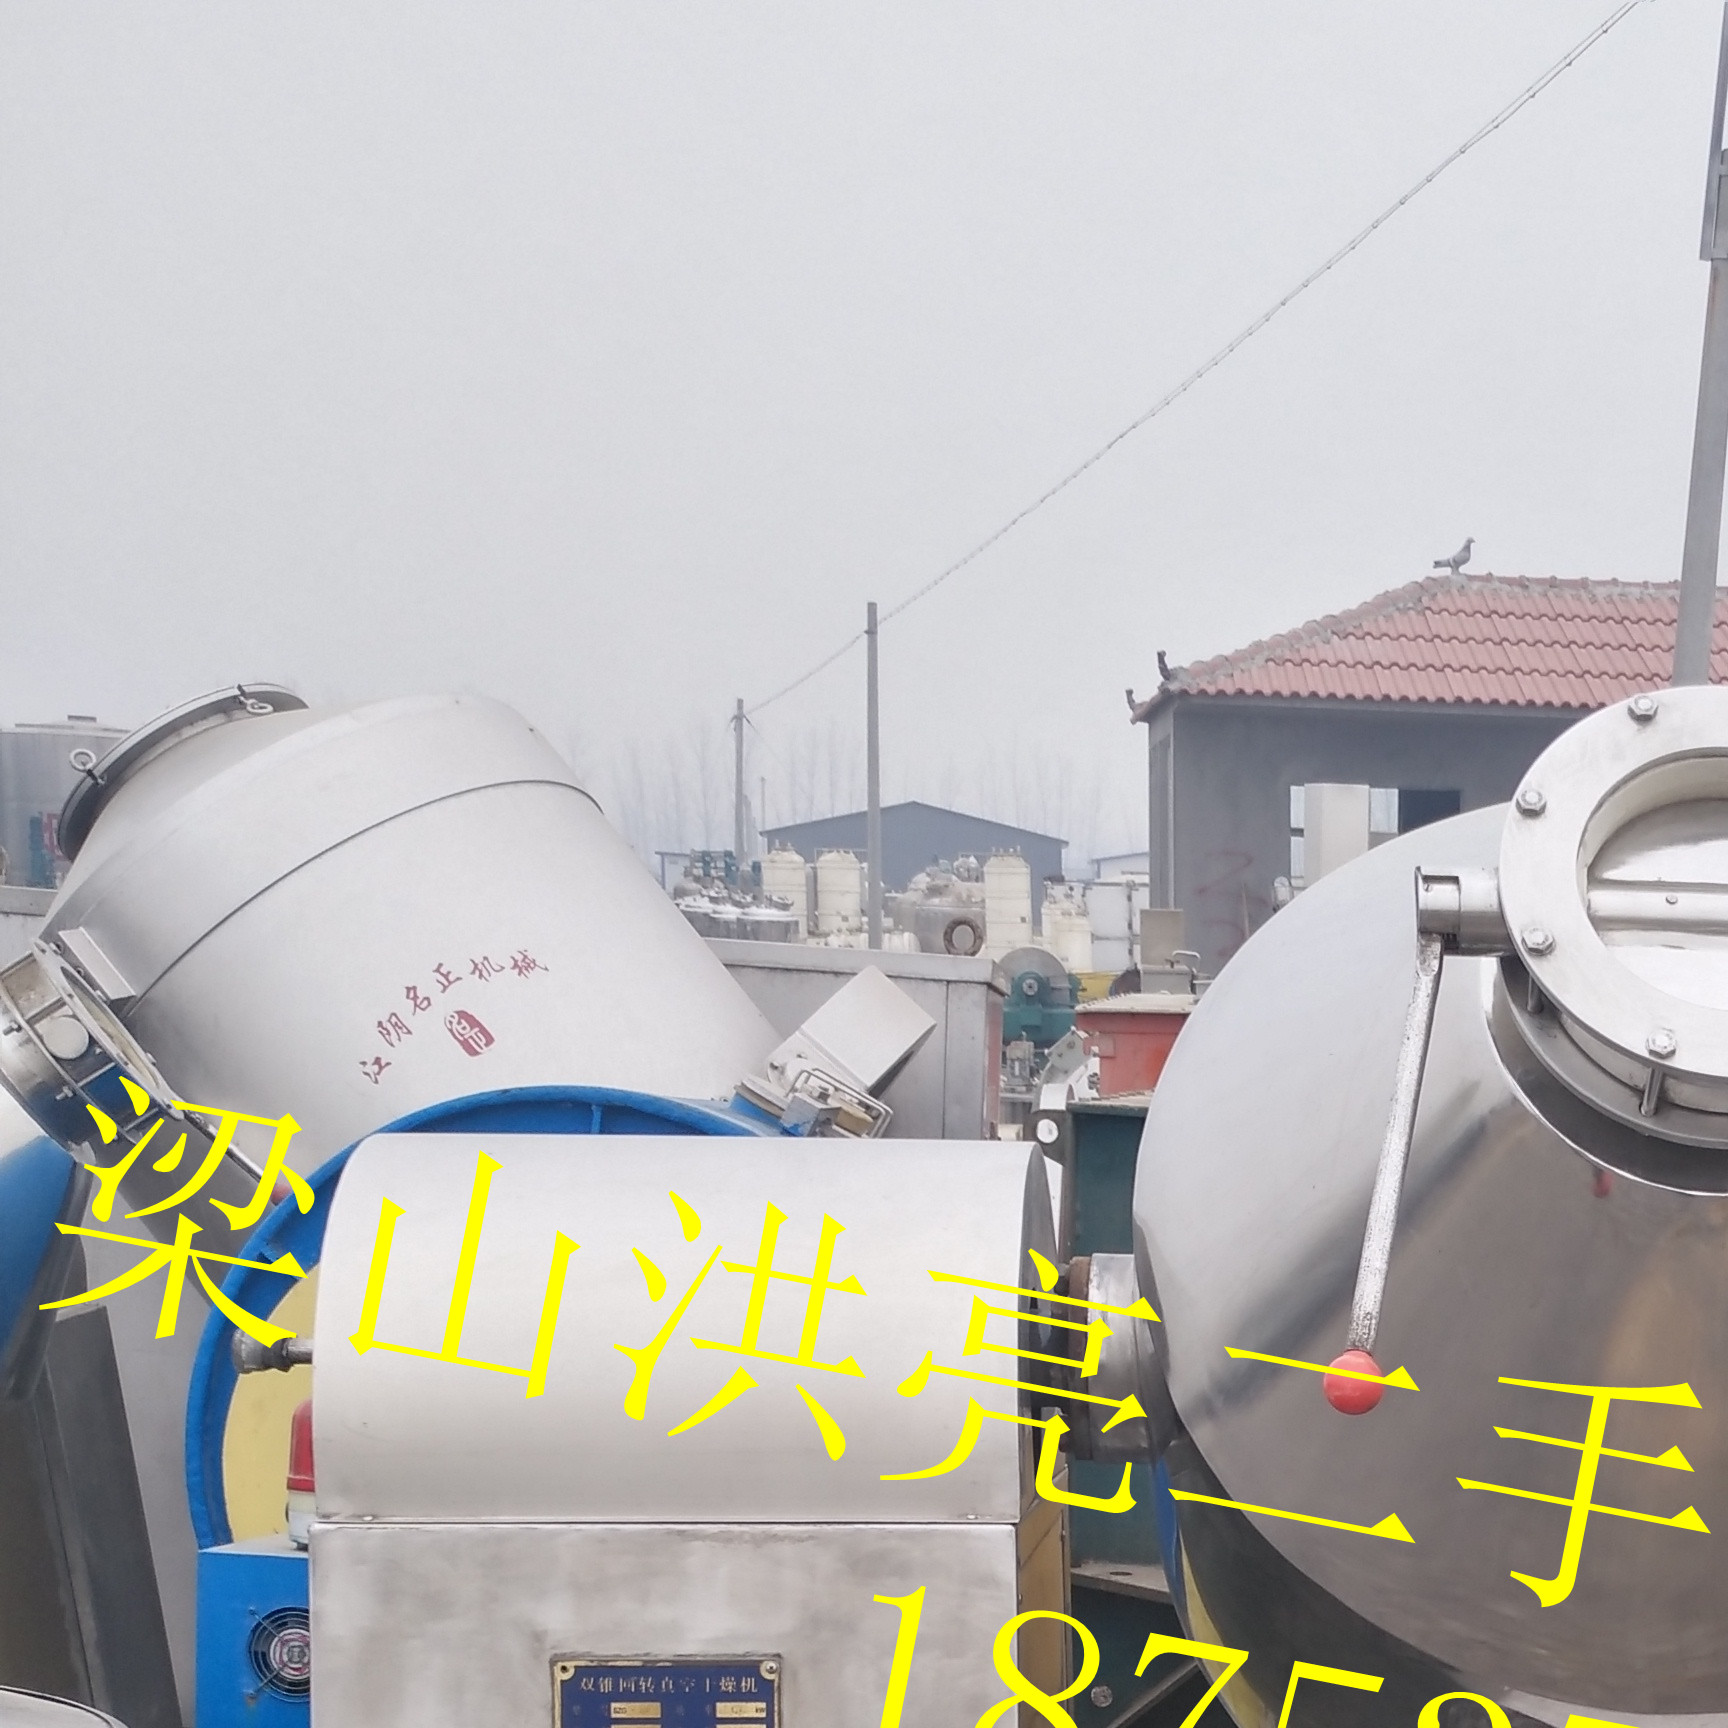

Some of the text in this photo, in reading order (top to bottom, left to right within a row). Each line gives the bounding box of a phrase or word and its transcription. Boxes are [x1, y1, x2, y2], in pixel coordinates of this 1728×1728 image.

[359, 948, 550, 1085] 江阴名正机械
